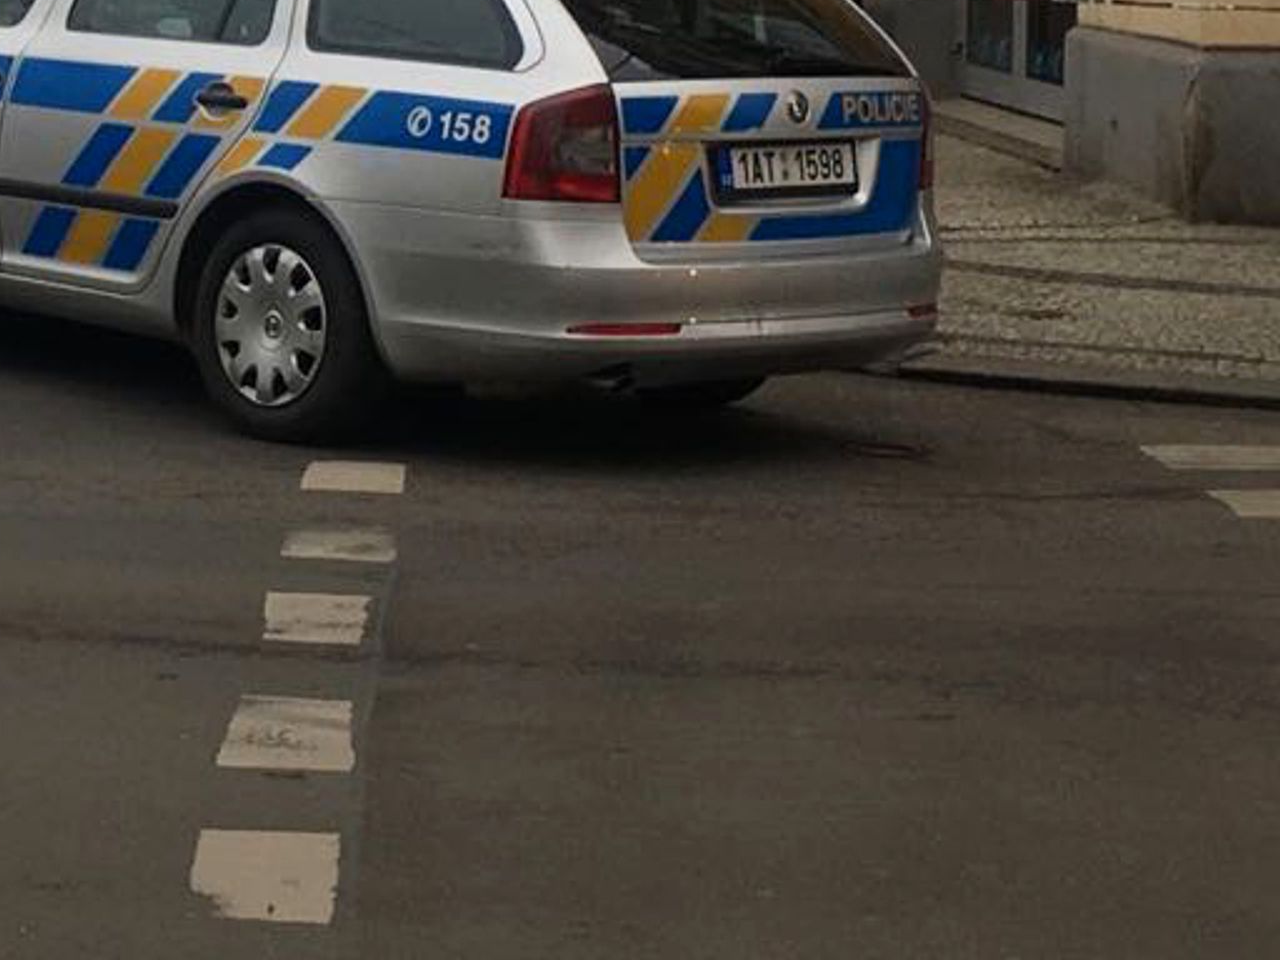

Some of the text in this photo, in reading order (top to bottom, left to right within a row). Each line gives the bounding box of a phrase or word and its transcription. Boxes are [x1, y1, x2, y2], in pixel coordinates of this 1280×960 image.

[842, 94, 919, 123] POLICIE
[440, 110, 491, 144] 158
[737, 147, 844, 185] 1AT 1598
